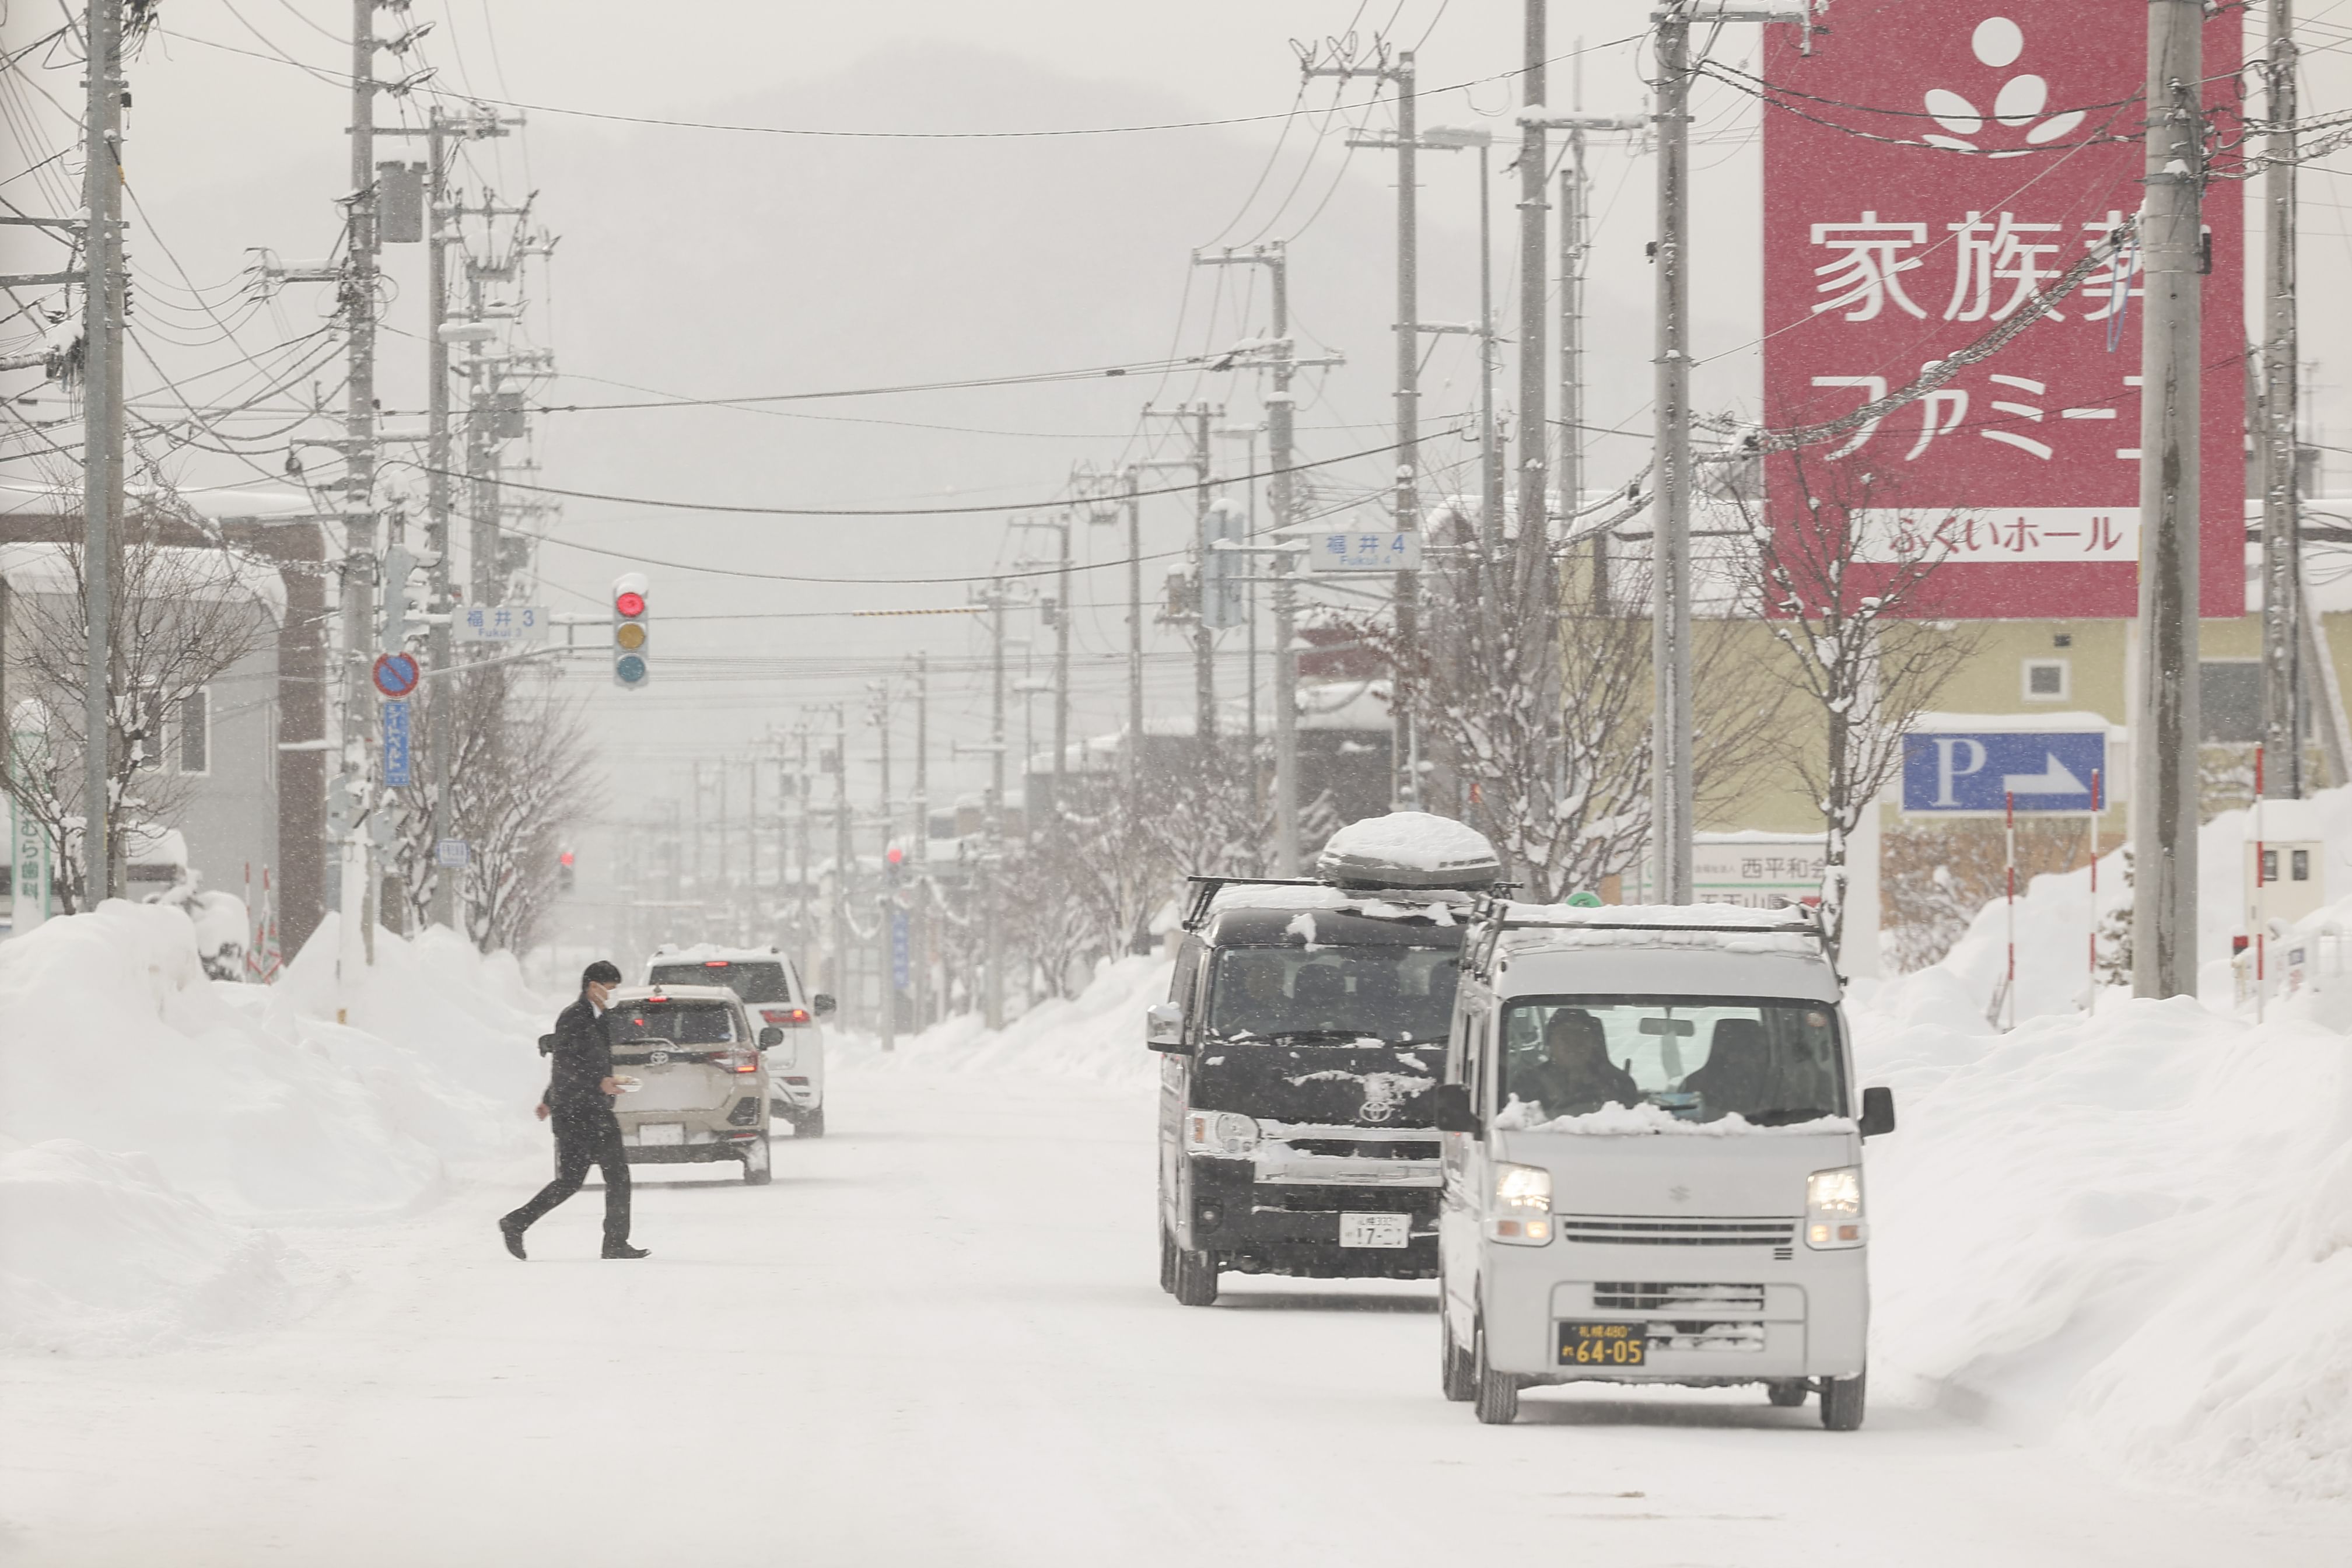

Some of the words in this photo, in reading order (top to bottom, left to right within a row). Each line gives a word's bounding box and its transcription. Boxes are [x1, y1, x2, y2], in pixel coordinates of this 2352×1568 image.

[1811, 373, 2143, 461] ファミー
[1889, 516, 2123, 554] ふくいホール
[1931, 738, 1987, 807] P
[1741, 857, 1825, 878] 西平和会
[1577, 1340, 1642, 1363] 64-05
